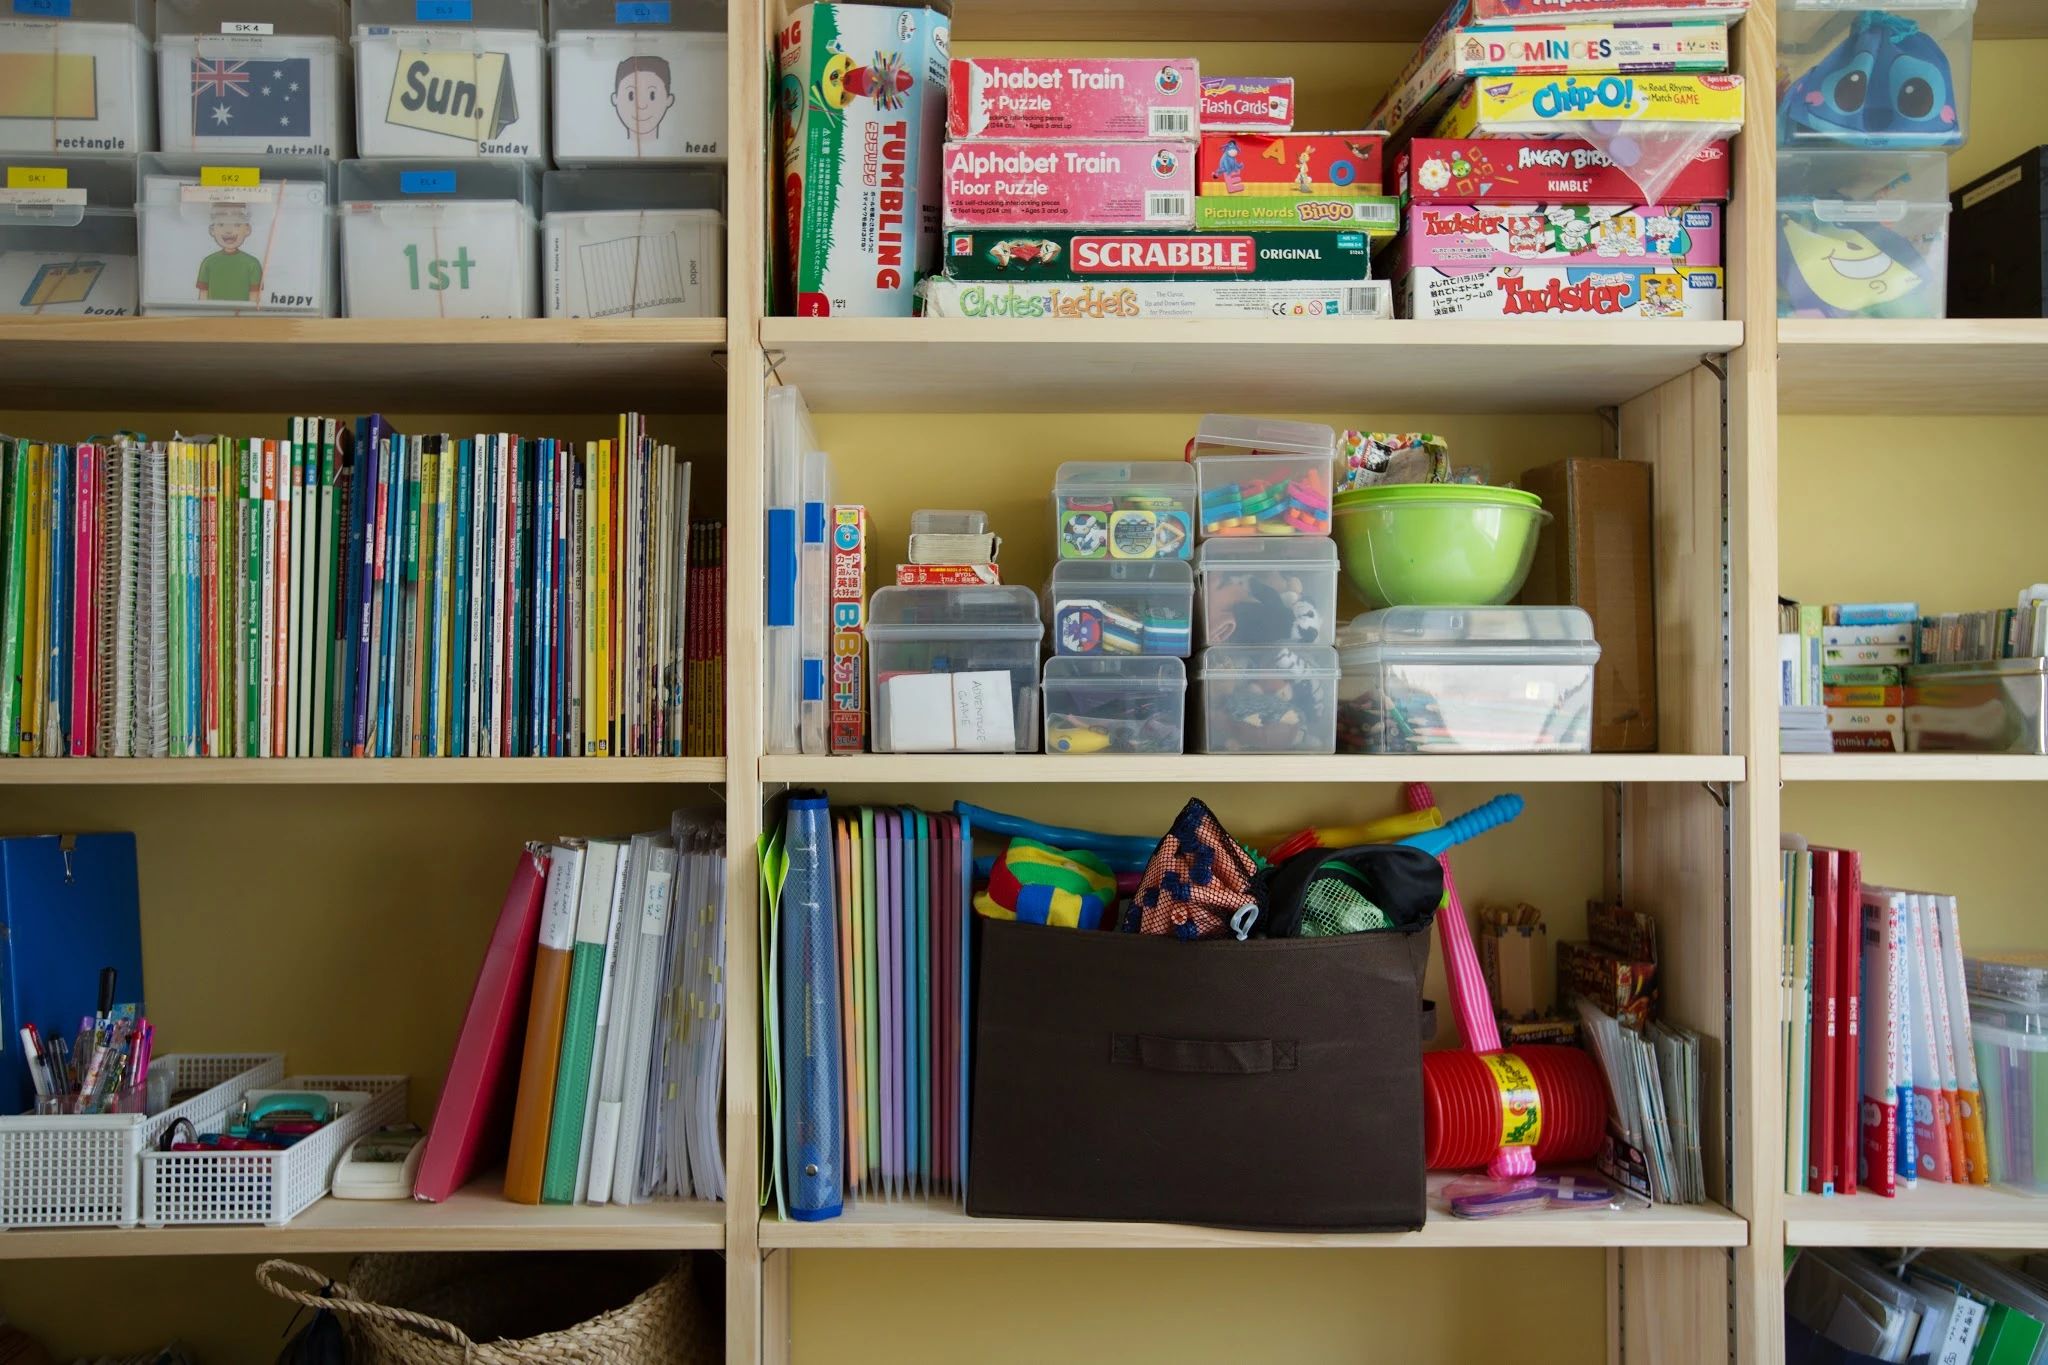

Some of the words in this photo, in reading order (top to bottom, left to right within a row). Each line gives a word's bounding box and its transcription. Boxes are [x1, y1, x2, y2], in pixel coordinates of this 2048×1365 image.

[901, 14, 909, 41] Pavilion
[1489, 38, 1612, 62] DOMINOES
[983, 67, 1063, 90] phabet
[1068, 68, 1124, 90] Train
[400, 60, 484, 120] Sun.
[1532, 76, 1634, 118] Chip-O!
[1669, 84, 1695, 93] Rhyme,
[999, 95, 1051, 111] Puzzle
[1200, 98, 1232, 114] Flash
[1234, 100, 1268, 114] Cards
[1651, 94, 1672, 102] Match
[1674, 94, 1700, 105] GAME
[1029, 122, 1044, 130] Ages
[56, 136, 125, 150] rectangle
[266, 144, 330, 157] Australia
[480, 142, 529, 155] Sunday
[686, 142, 717, 154] head
[1262, 138, 1286, 164] A
[951, 152, 1058, 178] Alphabet
[1064, 152, 1120, 173] Train
[1518, 147, 1570, 169] ANGRY
[221, 174, 240, 182] SK2
[1223, 171, 1244, 194] E
[1548, 180, 1589, 192] KIMBLE
[951, 180, 990, 196] Floor
[995, 180, 1048, 196] Puzzle
[877, 121, 907, 289] TUMBLING
[1204, 208, 1249, 218] Picture
[1252, 208, 1294, 218] Words
[1298, 202, 1353, 222] Bingo
[1423, 211, 1504, 236] Twister
[1078, 242, 1248, 267] SCRABBLE
[1260, 248, 1322, 260] ORIGINAL
[403, 244, 476, 290] 1st
[690, 260, 698, 286] paper
[270, 292, 313, 306] happy
[960, 285, 1044, 318] Chutes
[1050, 285, 1140, 318] Ladders
[1497, 276, 1631, 314] Twister
[84, 306, 128, 316] book
[265, 452, 274, 478] HEADS
[242, 477, 249, 487] UP
[252, 475, 258, 483] UP
[266, 478, 273, 489] UP
[837, 555, 859, 563] カード
[838, 568, 858, 576] 遊んで
[837, 578, 858, 588] 英語
[958, 690, 970, 729] GAME
[972, 680, 986, 744] ADVENTURE
[621, 860, 629, 890] English
[612, 942, 620, 958] Unit
